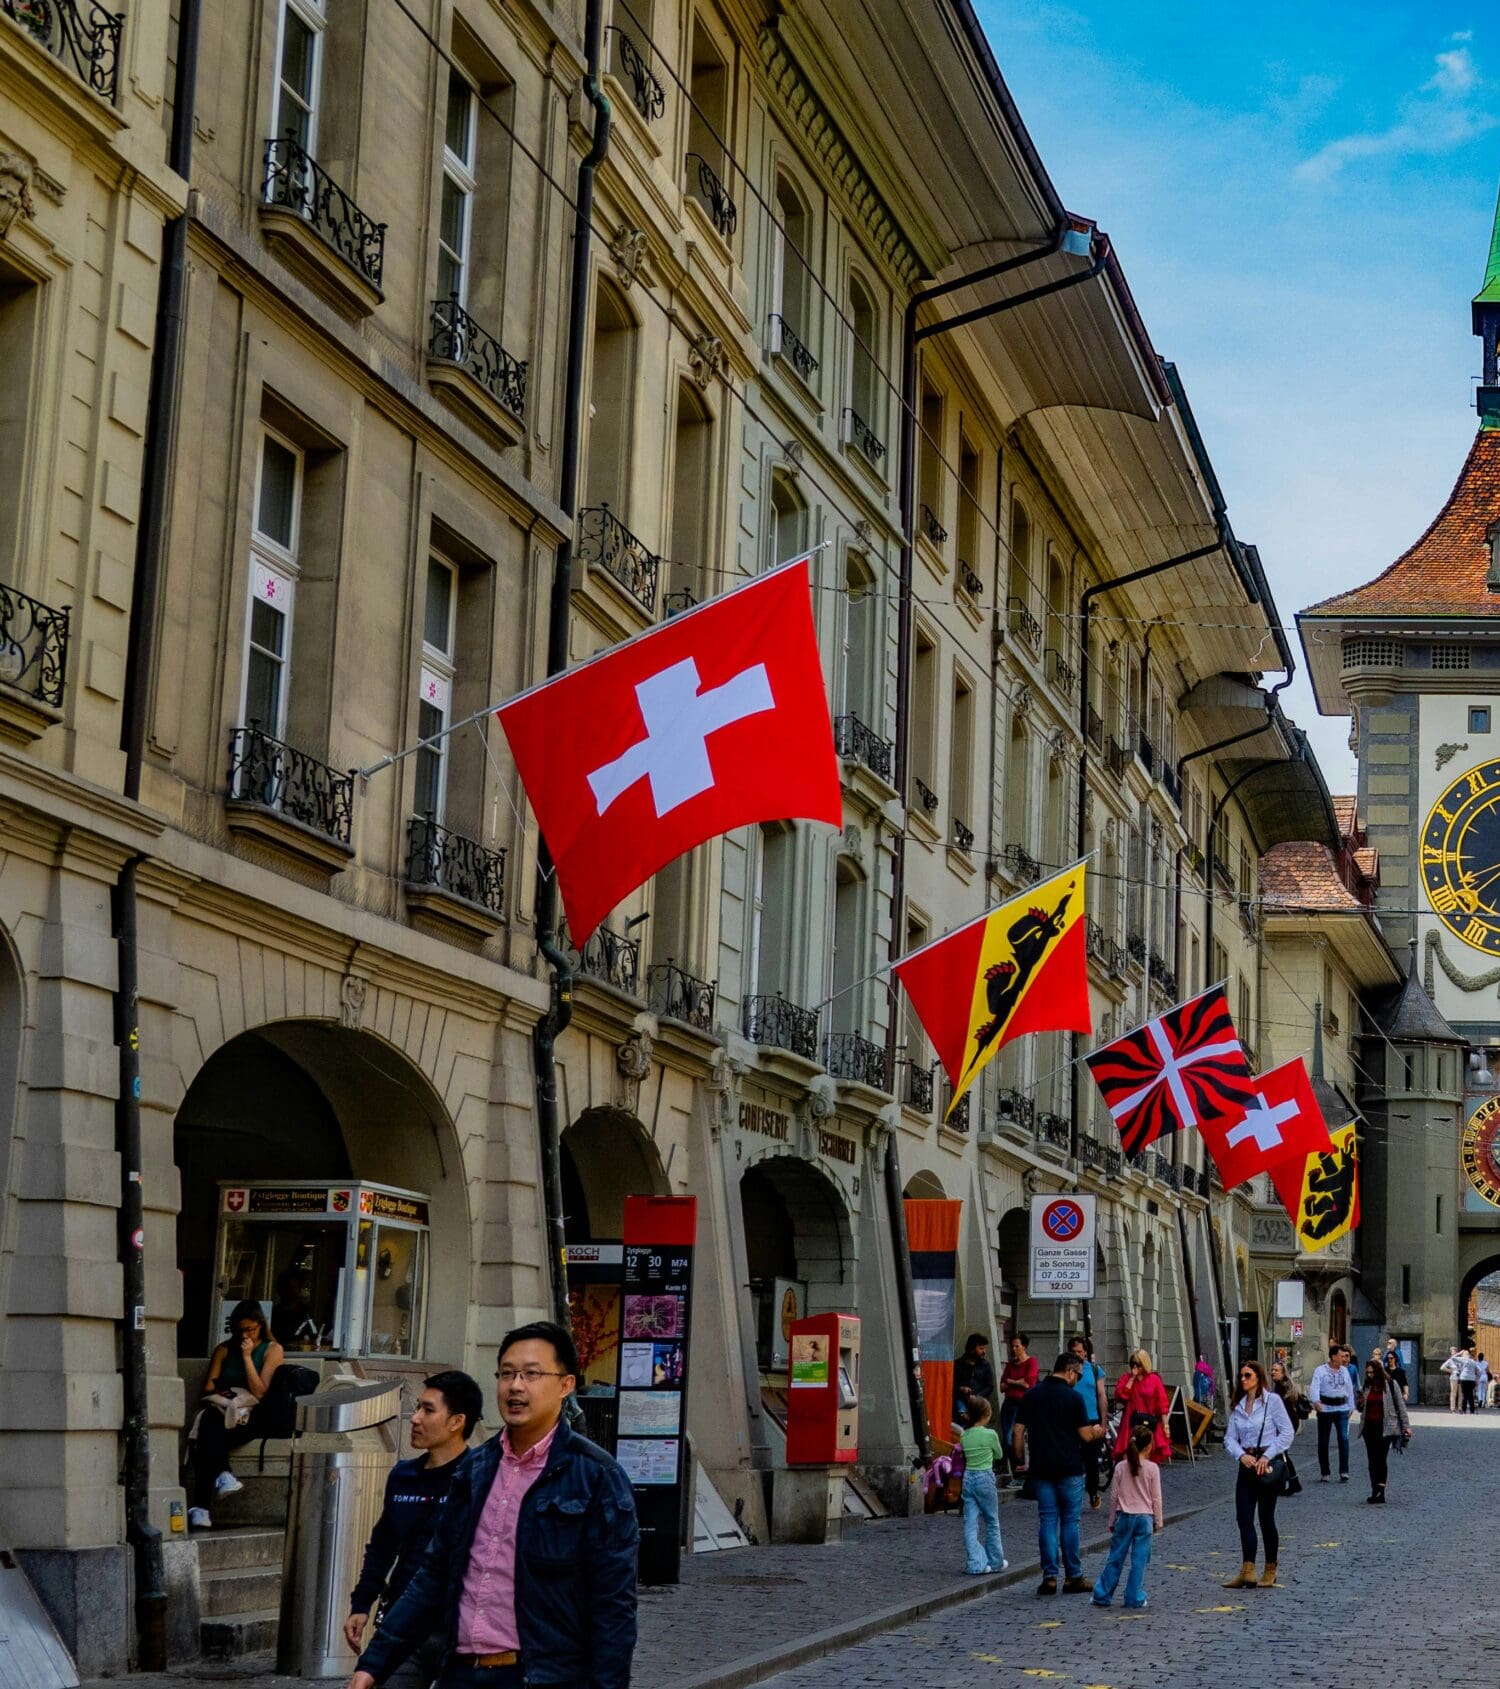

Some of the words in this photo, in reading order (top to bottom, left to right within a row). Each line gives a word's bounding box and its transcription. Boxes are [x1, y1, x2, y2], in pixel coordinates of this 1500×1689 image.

[1467, 771, 1486, 794] XI
[1437, 804, 1453, 823] X
[1424, 845, 1442, 864] IX
[1431, 885, 1456, 912] VIII
[1463, 920, 1488, 945] VII
[738, 1102, 790, 1142] CONFISERIE
[292, 1190, 327, 1201] Boutique
[626, 1256, 637, 1266] 12
[648, 1256, 661, 1266] 30
